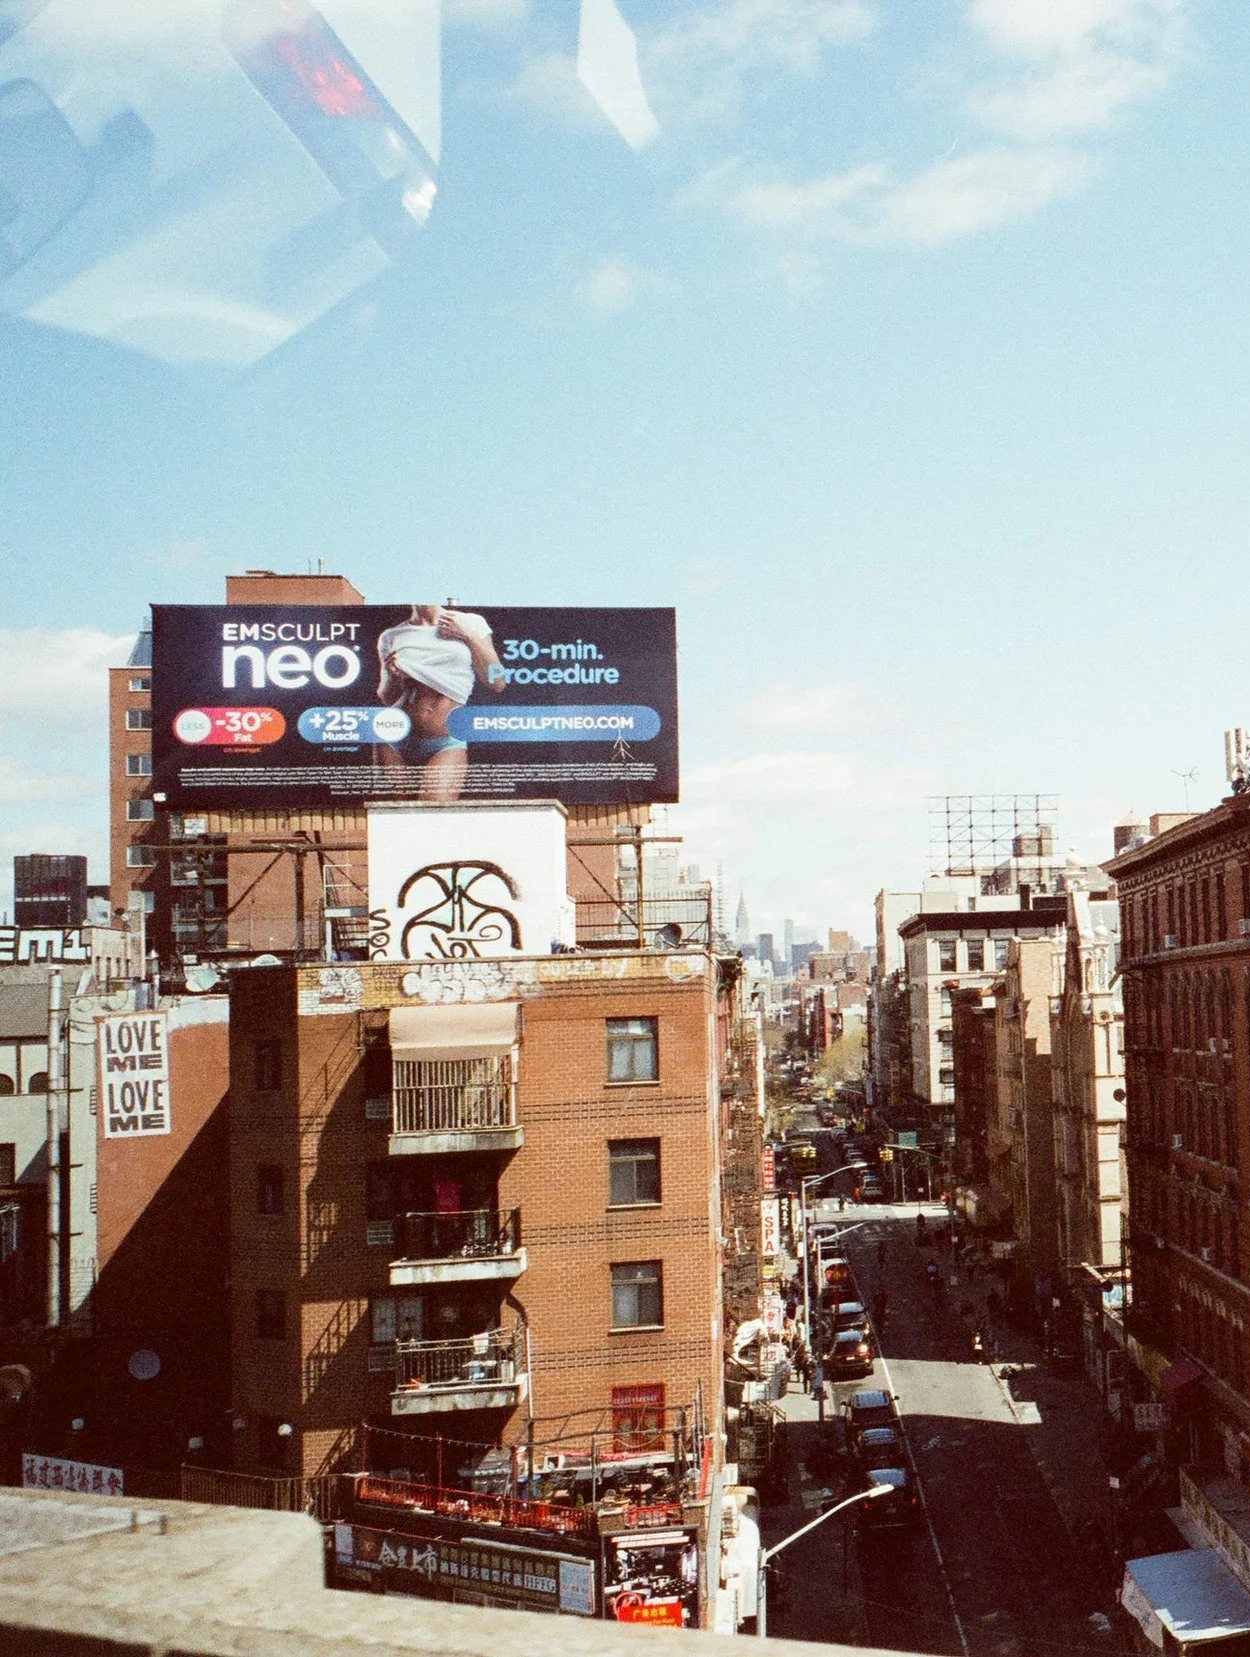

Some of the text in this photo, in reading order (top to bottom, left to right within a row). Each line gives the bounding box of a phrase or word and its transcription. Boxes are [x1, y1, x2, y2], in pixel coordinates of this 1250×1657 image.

[223, 623, 361, 641] EMSCULPT
[503, 639, 604, 660] 30-min.
[222, 645, 361, 689] neo
[487, 663, 620, 685] Procedure
[181, 722, 205, 730] LESS
[375, 720, 405, 729] MORE
[473, 716, 634, 730] EMSCULPTNEO.COM
[234, 732, 253, 742] Fat
[322, 731, 360, 742] Muscle
[106, 1019, 161, 1055] LOVE
[107, 1053, 163, 1073] ME
[108, 1079, 164, 1115] LOVE
[109, 1113, 165, 1134] ME
[764, 1216, 775, 1252] SPA
